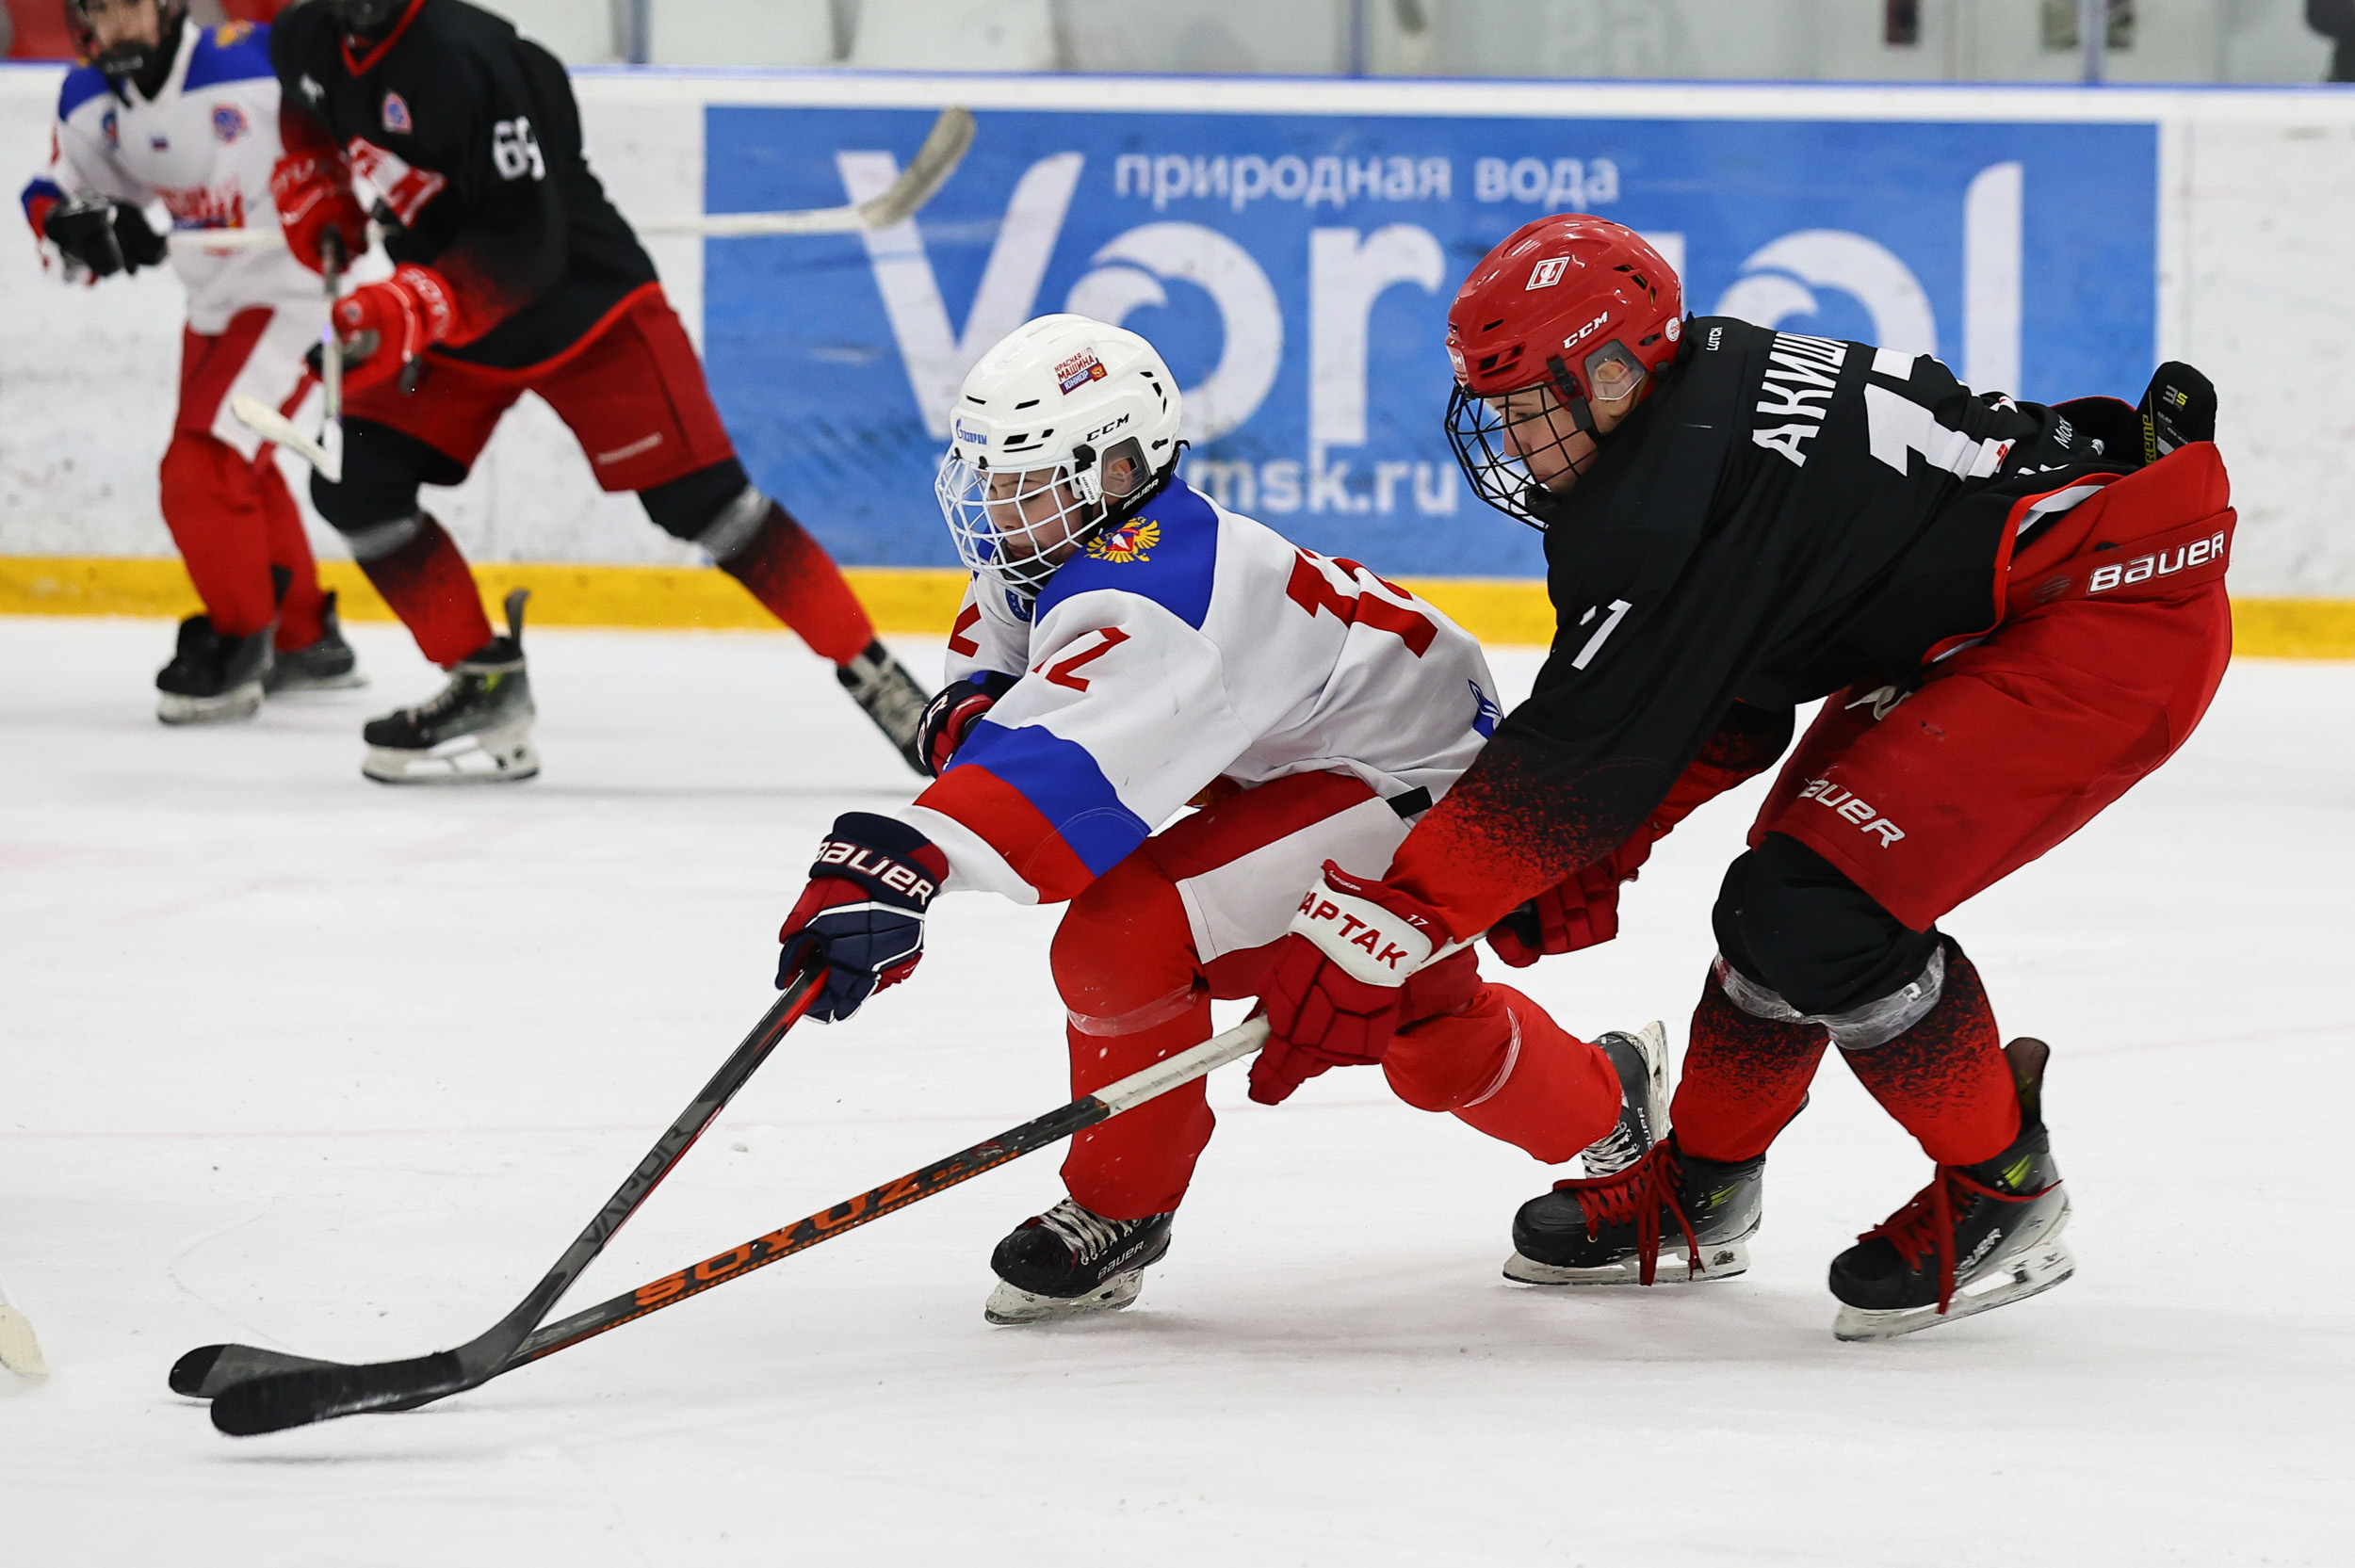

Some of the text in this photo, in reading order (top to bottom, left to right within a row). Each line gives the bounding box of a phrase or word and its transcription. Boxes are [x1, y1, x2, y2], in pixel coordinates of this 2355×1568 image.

[1115, 153, 1619, 213] природная вода
[1563, 311, 1608, 349] CCM
[1057, 354, 1096, 382] МАШИНА
[1064, 370, 1089, 391] ЮНИОР
[1086, 412, 1130, 443] CCM
[1184, 435, 1462, 517] msk.ru
[1797, 779, 1906, 849] AUER
[1297, 891, 1408, 970] АРТАК
[1406, 913, 1429, 927] 17
[635, 1172, 921, 1307] SOYUZ
[1096, 1240, 1145, 1280] BAUER
